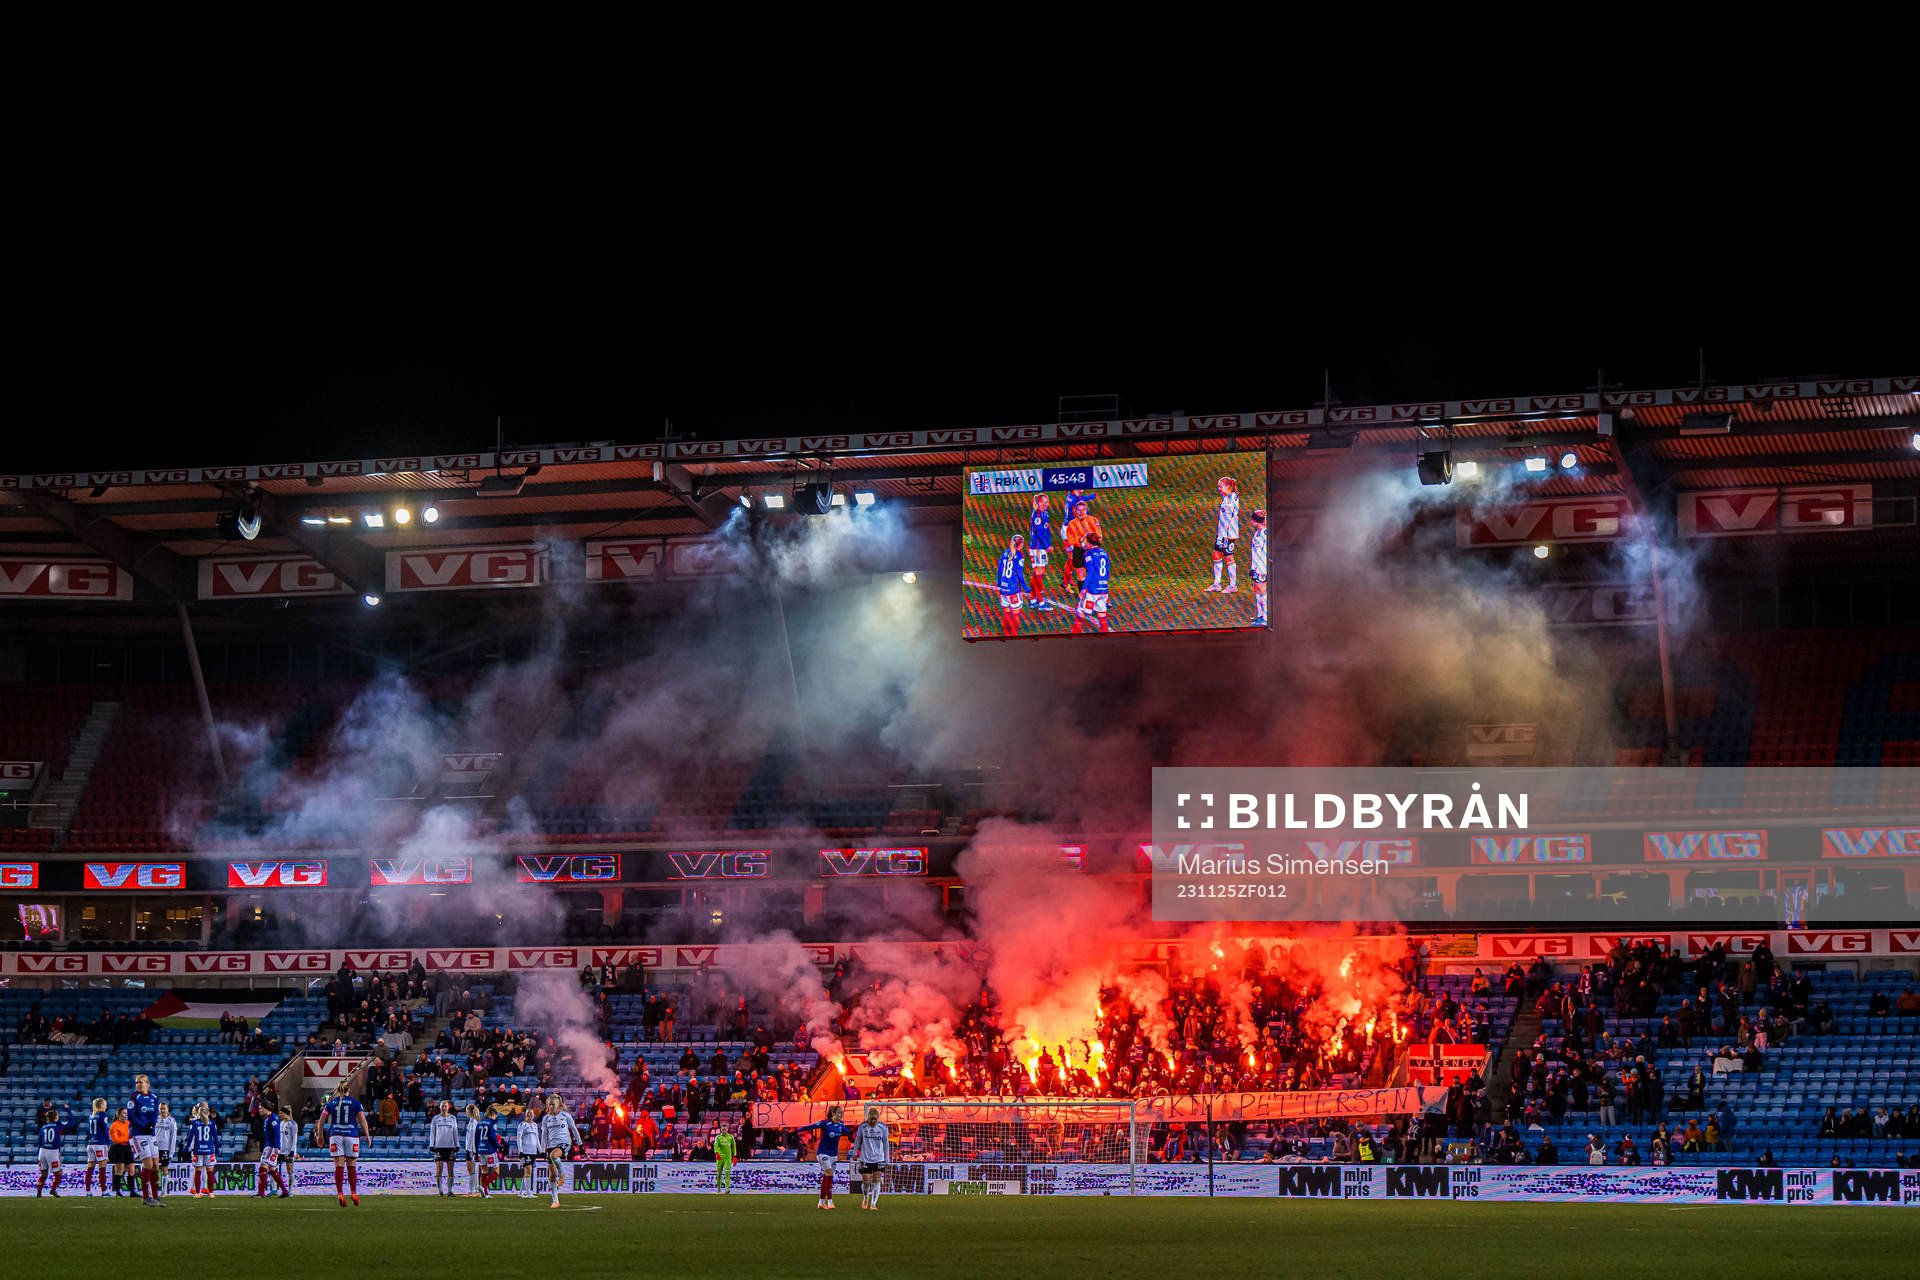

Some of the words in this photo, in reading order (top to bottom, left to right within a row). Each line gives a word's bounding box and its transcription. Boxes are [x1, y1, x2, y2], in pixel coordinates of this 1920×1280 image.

[1746, 386, 1794, 398] VG
[1822, 381, 1870, 394] VG
[1534, 396, 1581, 409] VG
[1605, 392, 1652, 405] VG
[1675, 389, 1723, 402] VG
[1328, 408, 1373, 420] VG
[1394, 404, 1441, 417] VG
[1464, 400, 1511, 413] VG
[1124, 420, 1170, 432] VG
[1193, 416, 1238, 428] VG
[1258, 412, 1305, 425] VG
[930, 431, 974, 442] VG
[994, 428, 1039, 440] VG
[1059, 424, 1105, 436] VG
[740, 440, 784, 452] VG
[803, 437, 847, 449] VG
[866, 434, 911, 446] VG
[556, 450, 599, 461] VG
[617, 446, 659, 458] VG
[678, 443, 721, 455] VG
[378, 459, 418, 470] VG
[435, 456, 478, 467] VG
[500, 452, 538, 464] VG
[205, 468, 244, 480] VG
[261, 466, 301, 477] VG
[319, 462, 360, 474] VG
[0, 477, 17, 488] G
[34, 476, 73, 486] VG
[91, 473, 130, 484] VG
[148, 470, 187, 482] VG
[995, 476, 1020, 487] RBK
[1049, 472, 1086, 485] 45:48
[1118, 470, 1138, 481] VIF
[1700, 493, 1845, 530] VG
[404, 552, 527, 585] VG
[0, 564, 110, 593] VG
[217, 560, 336, 593] VG
[0, 763, 31, 778] G
[1475, 836, 1585, 862] VG
[1648, 833, 1761, 859] VG
[519, 856, 615, 880] VG
[668, 853, 768, 878] VG
[822, 850, 922, 874] VG
[0, 864, 33, 887] G
[88, 864, 180, 887] VG
[231, 862, 322, 886] VG
[373, 859, 467, 883] VG
[1496, 938, 1568, 955] VG
[1792, 934, 1868, 952] VG
[1894, 932, 1920, 950] V
[21, 956, 84, 971] VG
[104, 956, 166, 971] VG
[188, 955, 246, 970] VG
[267, 953, 328, 970] VG
[348, 952, 408, 968] VG
[430, 952, 491, 968] VG
[512, 951, 574, 967] VG
[335, 1105, 350, 1124] 11
[757, 1102, 792, 1126] BY
[43, 1128, 56, 1143] 10
[197, 1126, 210, 1142] 18
[168, 1164, 190, 1178] mini
[574, 1164, 630, 1191] KIWI
[632, 1165, 658, 1178] mini
[1344, 1167, 1372, 1182] mini
[1452, 1168, 1481, 1182] mini
[1786, 1171, 1816, 1186] mini
[167, 1178, 188, 1194] pris
[632, 1178, 656, 1194] pris
[950, 1182, 988, 1195] KIWI
[989, 1182, 1006, 1190] mini
[1278, 1166, 1342, 1196] KIWI
[1386, 1166, 1450, 1197] KIWI
[1716, 1169, 1784, 1200] KIWI
[1832, 1170, 1900, 1202] KIWI
[1344, 1182, 1370, 1199] pris
[1452, 1182, 1479, 1200] pris
[1786, 1186, 1814, 1204] pris
